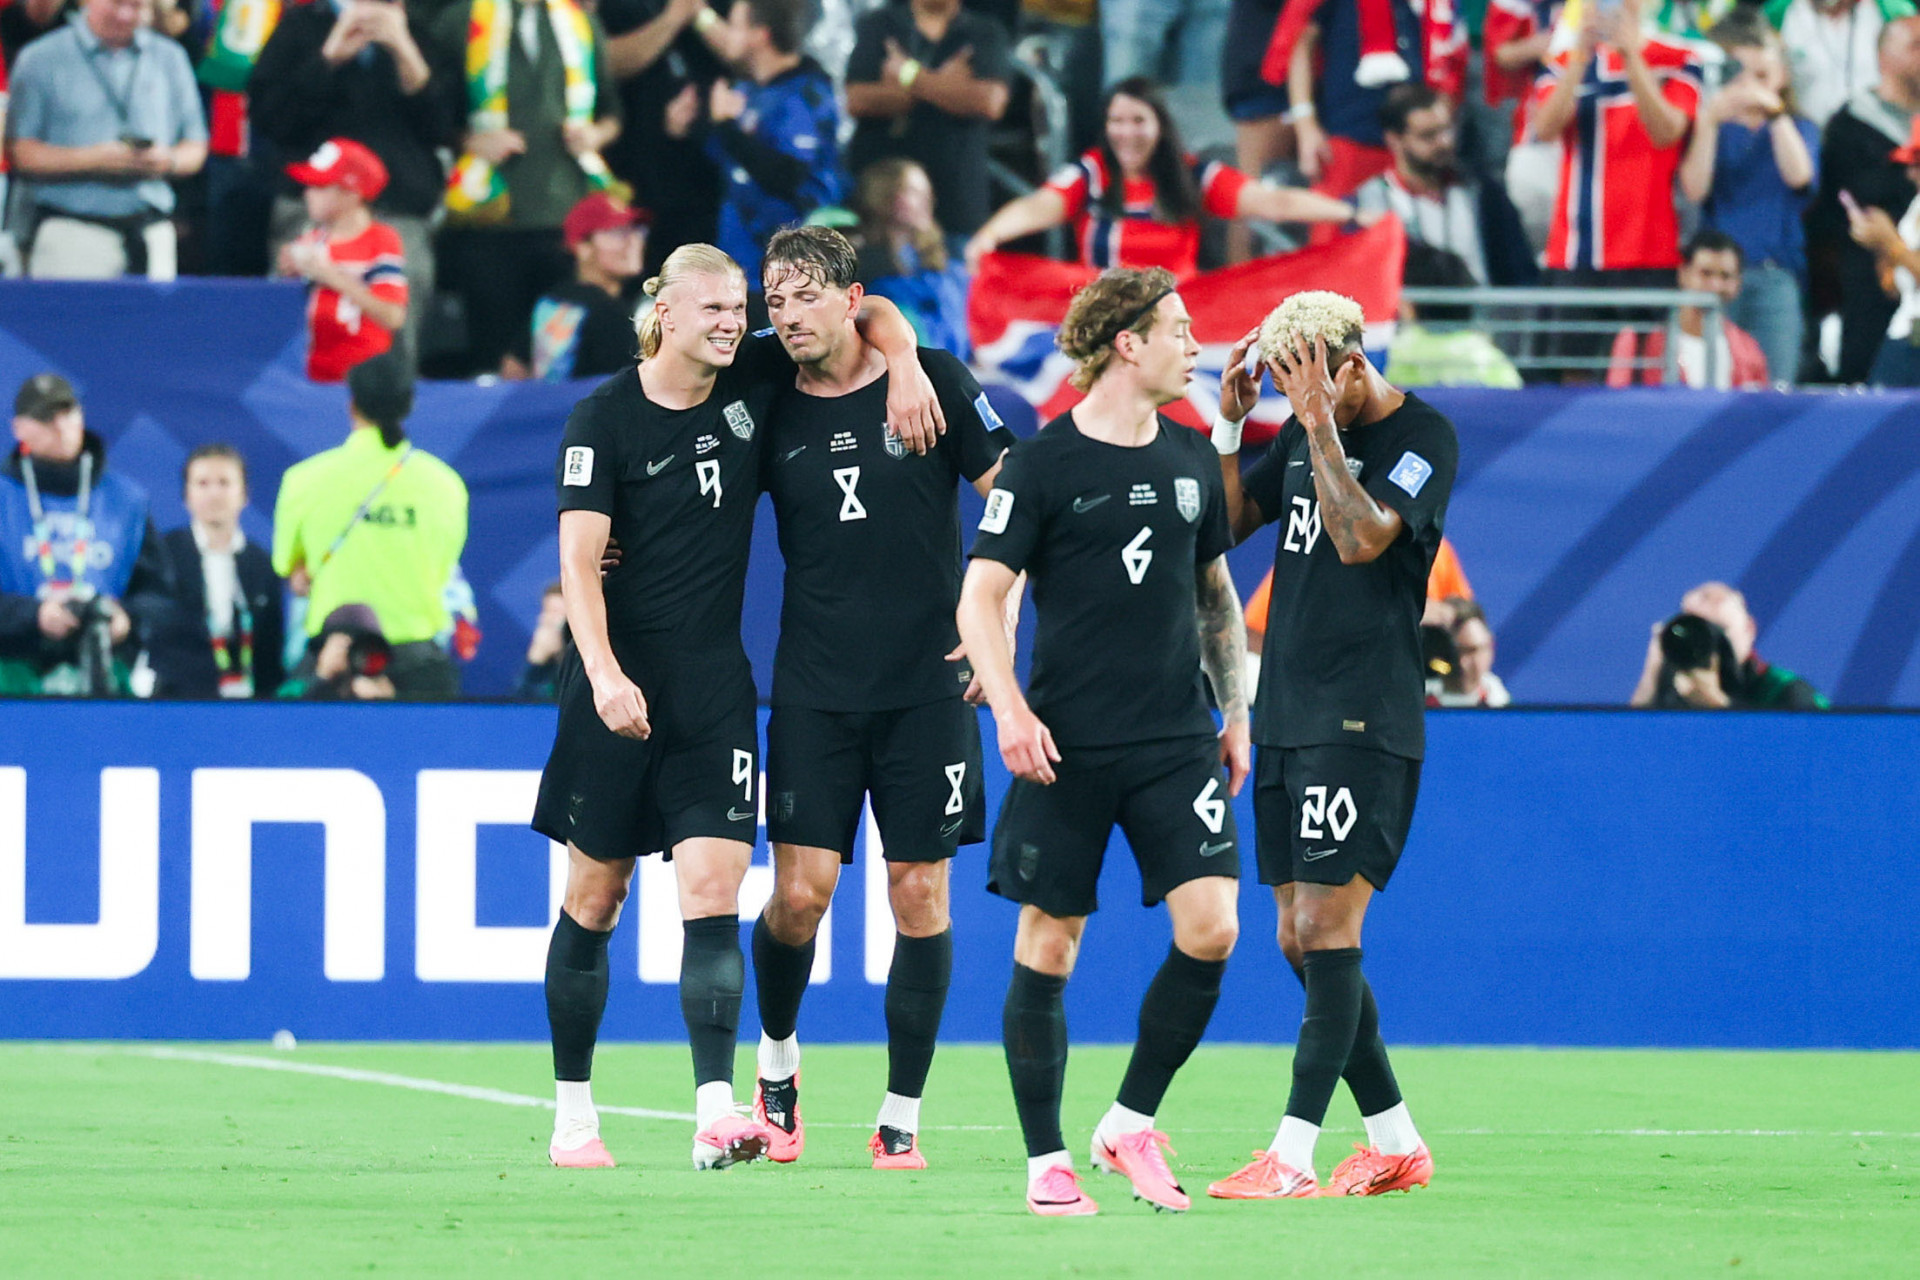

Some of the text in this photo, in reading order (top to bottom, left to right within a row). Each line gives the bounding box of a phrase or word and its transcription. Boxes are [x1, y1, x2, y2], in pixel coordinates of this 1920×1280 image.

[695, 459, 724, 509] 9
[832, 465, 868, 522] 8
[1283, 494, 1323, 555] 20
[1121, 525, 1153, 585] 6
[731, 748, 753, 802] 9
[944, 760, 967, 816] 8
[1192, 777, 1226, 834] 6
[1300, 785, 1358, 842] 20
